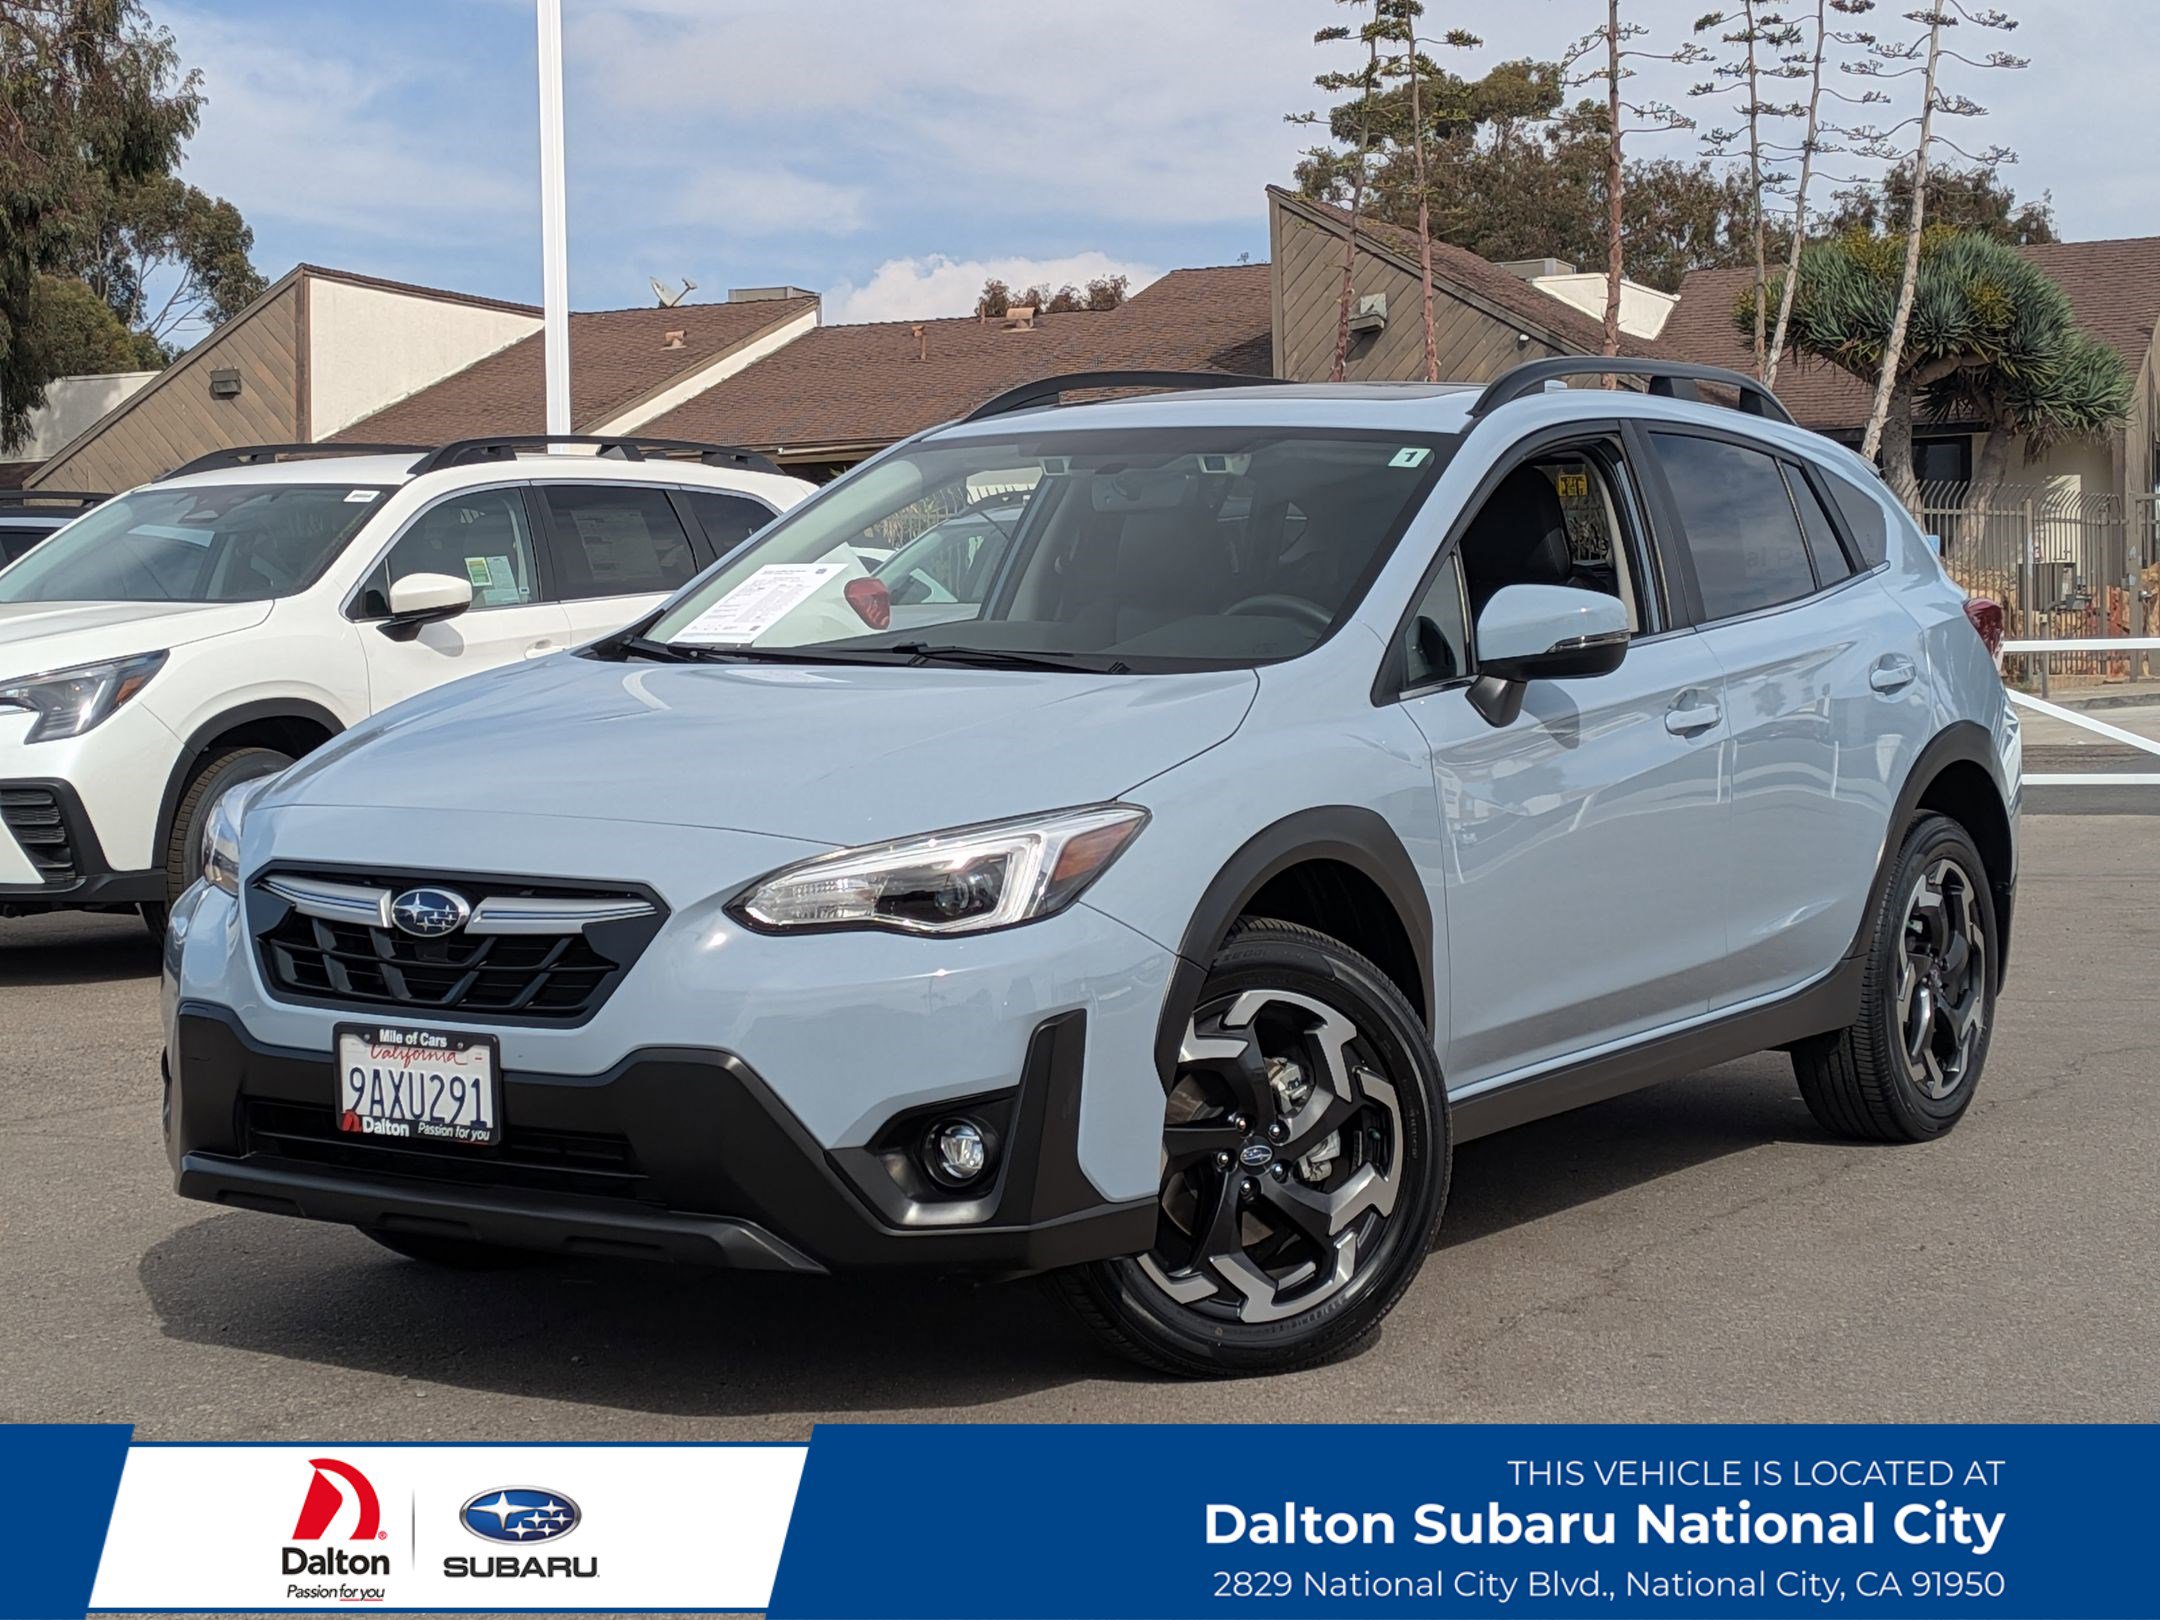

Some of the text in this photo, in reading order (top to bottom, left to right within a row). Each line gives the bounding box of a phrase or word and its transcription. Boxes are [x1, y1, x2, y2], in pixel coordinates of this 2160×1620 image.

[379, 1029, 447, 1048] Mile of Cars
[370, 1044, 468, 1069] California
[350, 1066, 487, 1128] 9AXU291
[362, 1117, 490, 1142] Dalton Passion for you
